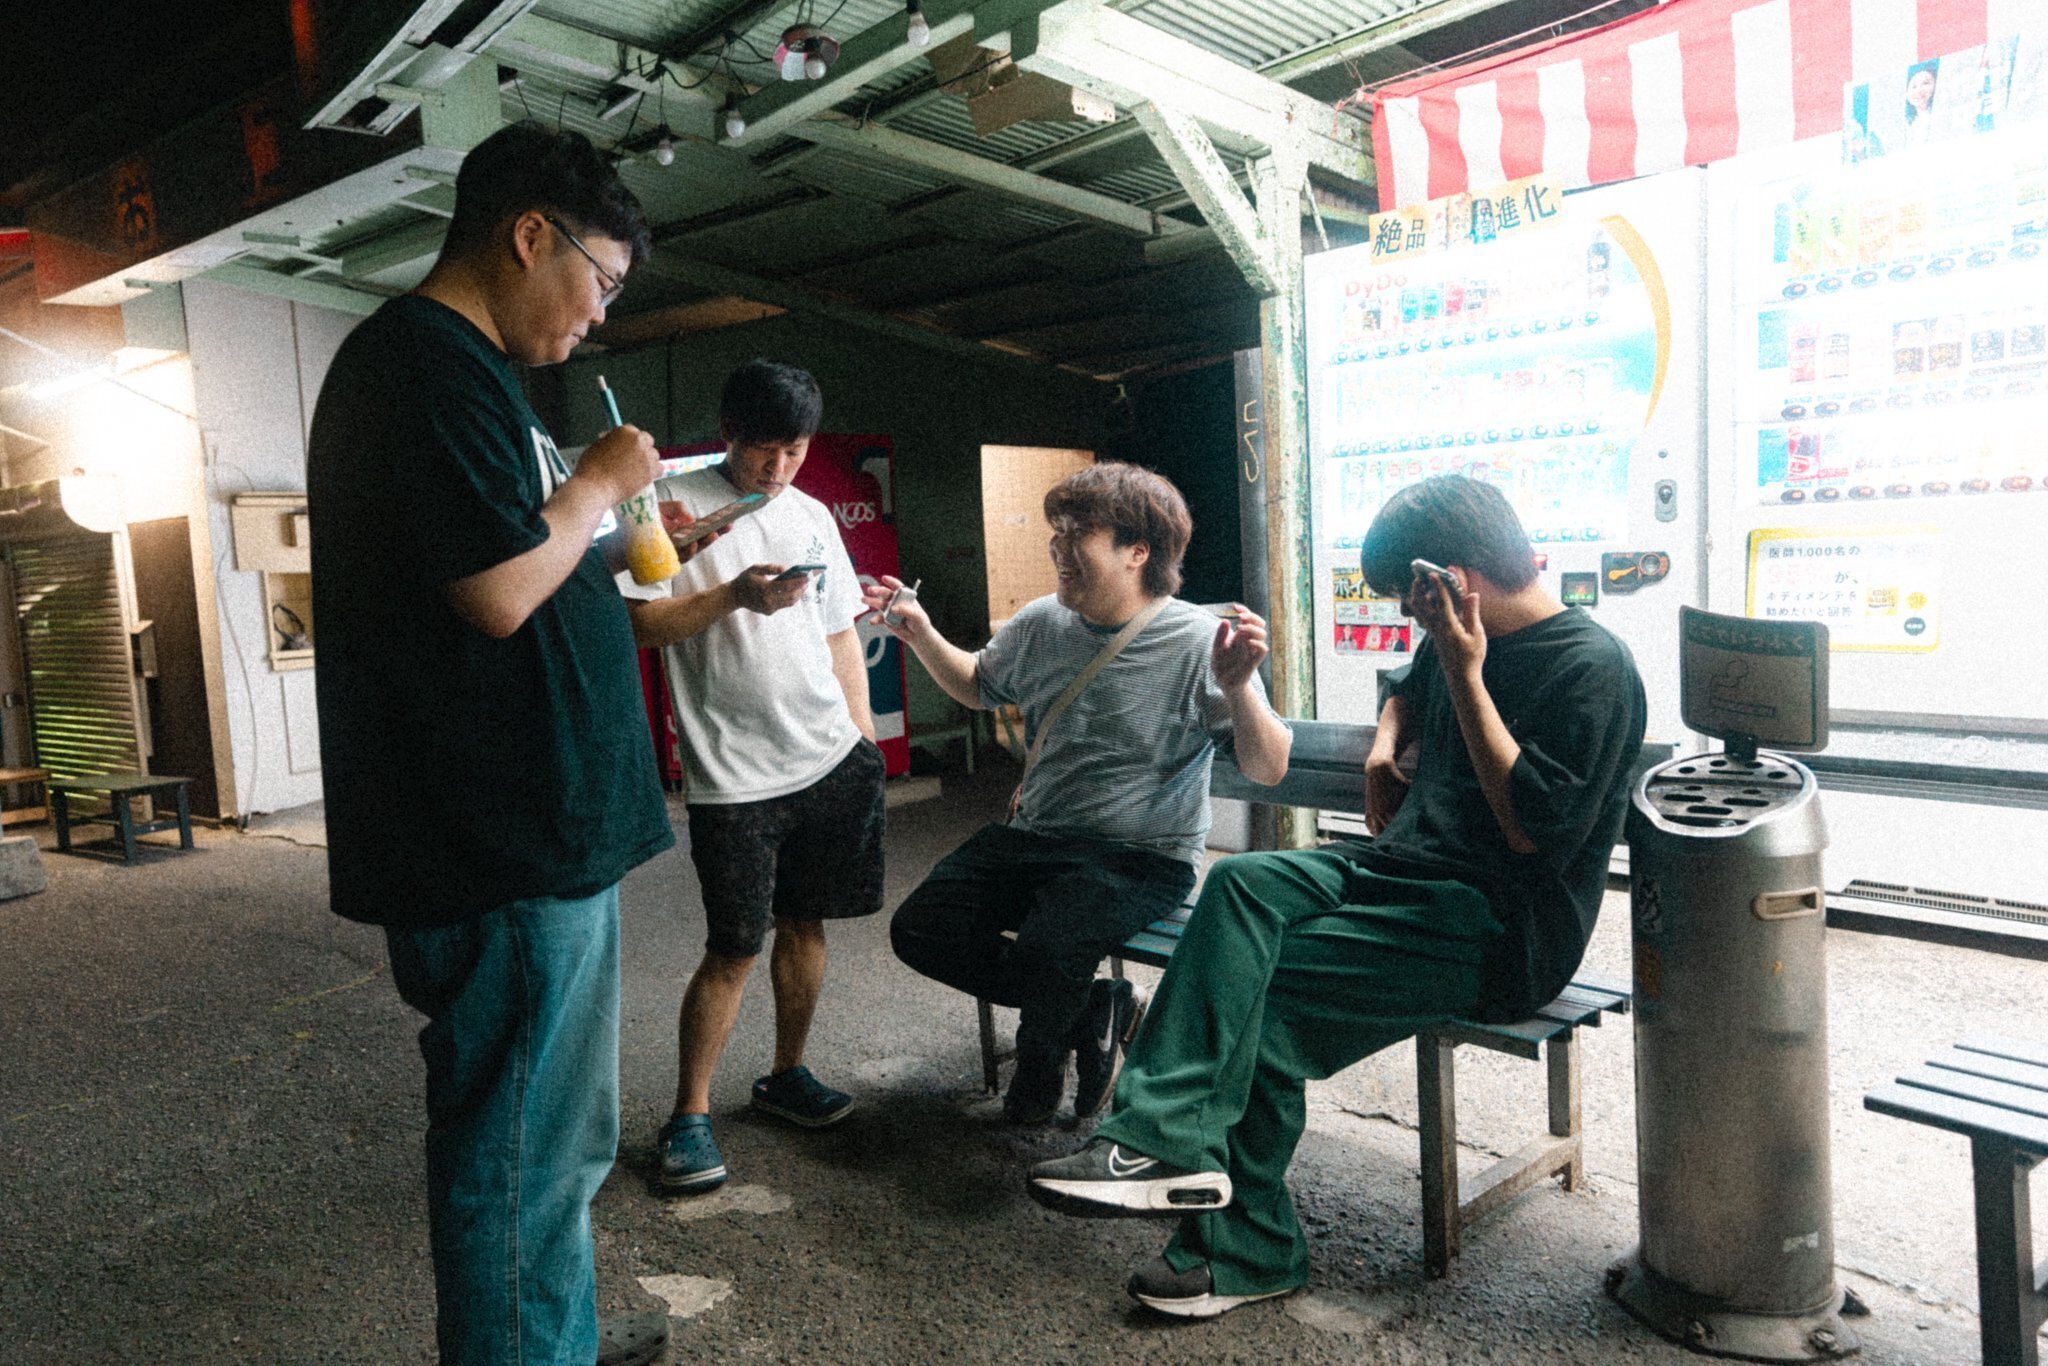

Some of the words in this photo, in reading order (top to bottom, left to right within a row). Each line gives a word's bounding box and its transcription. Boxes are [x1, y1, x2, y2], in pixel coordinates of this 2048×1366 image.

[1372, 218, 1426, 256] 絶品
[1495, 184, 1557, 231] 進化
[1344, 272, 1408, 299] DyDo
